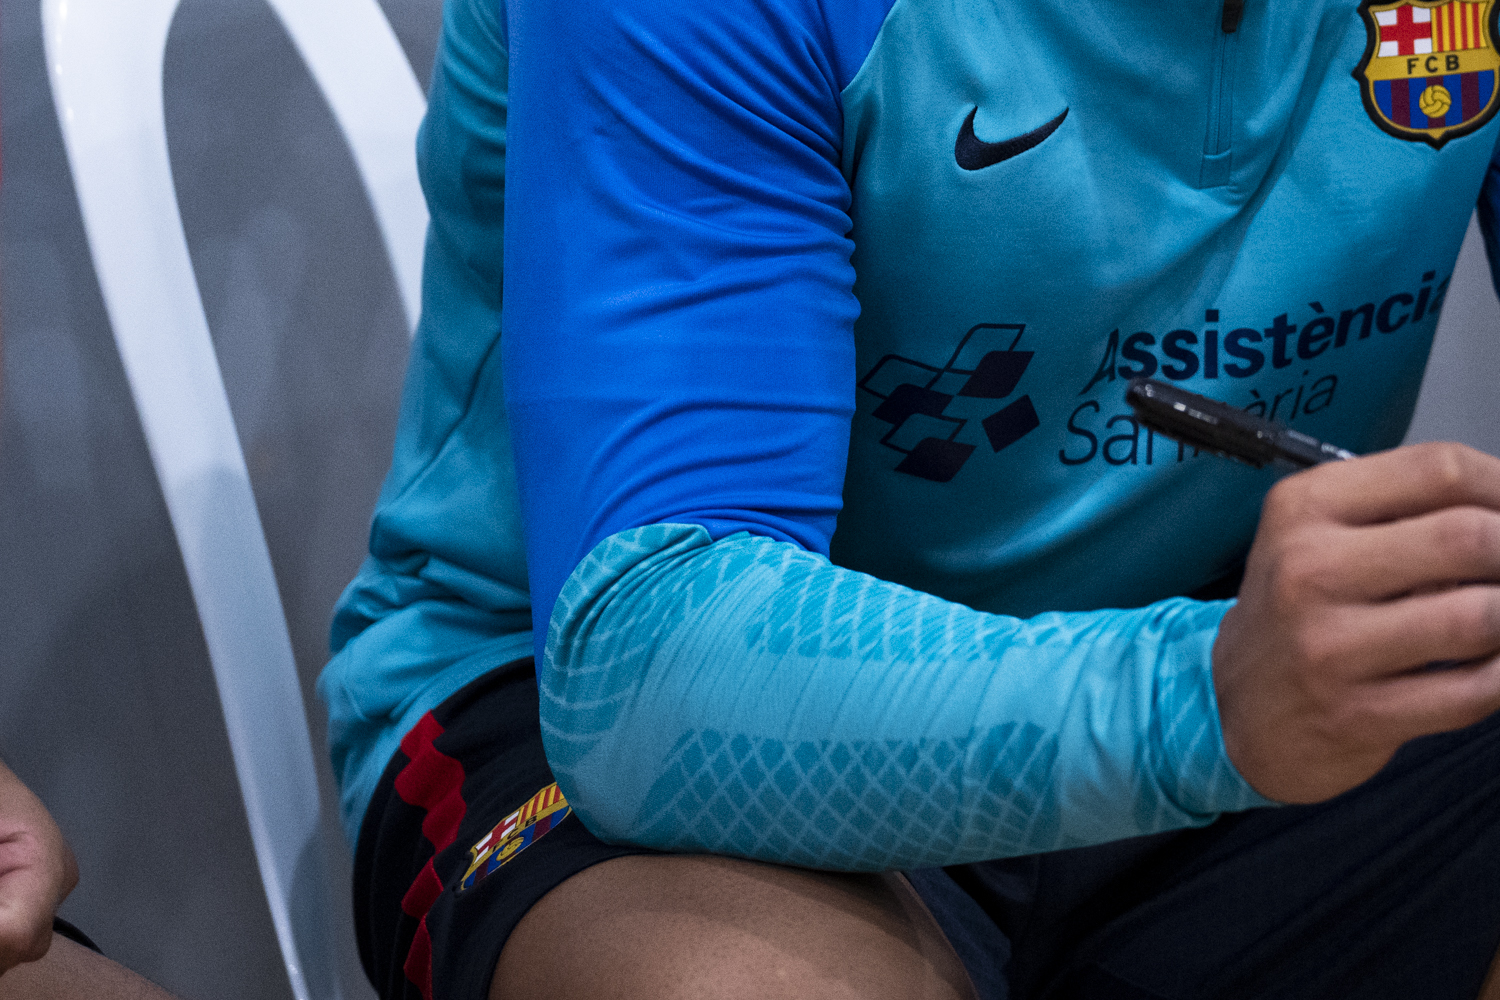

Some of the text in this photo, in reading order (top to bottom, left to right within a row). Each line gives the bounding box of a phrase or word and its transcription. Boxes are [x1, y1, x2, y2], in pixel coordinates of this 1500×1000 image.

[1406, 54, 1460, 75] FCB
[1058, 368, 1339, 467] Saària
[492, 815, 538, 853] FCB
